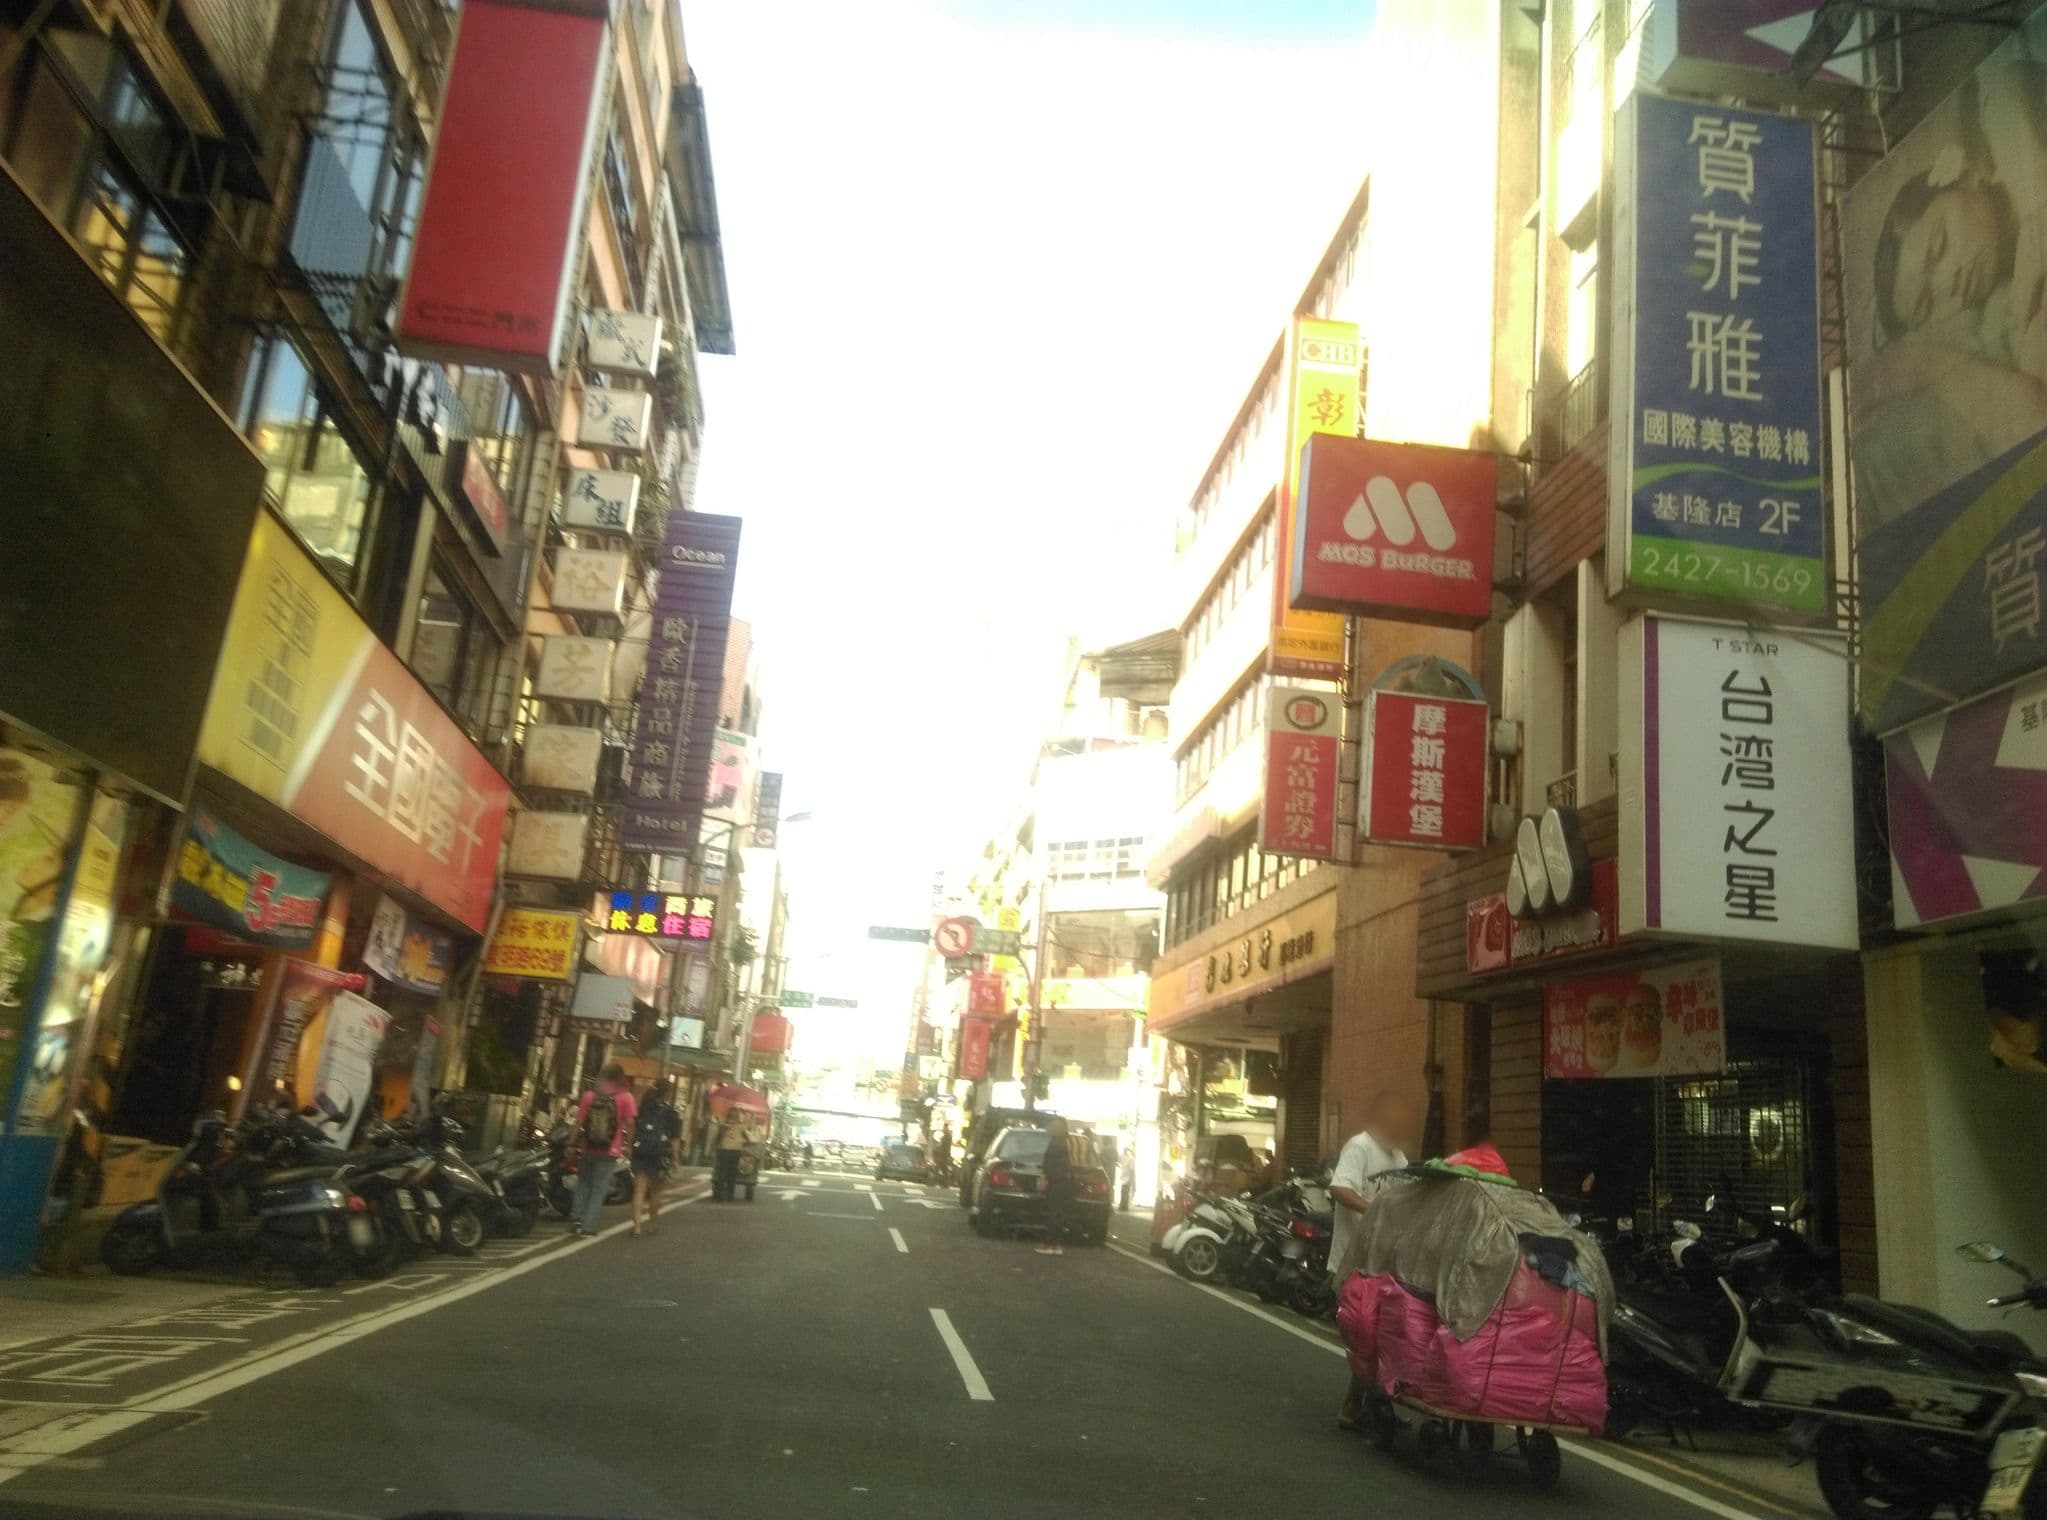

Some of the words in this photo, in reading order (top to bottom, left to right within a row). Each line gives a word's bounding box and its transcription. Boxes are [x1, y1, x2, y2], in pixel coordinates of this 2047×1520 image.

[1685, 116, 1764, 401] 質菲雅
[1643, 408, 1810, 467] 國際美容機構
[1652, 490, 1743, 530] 基隆店
[1758, 498, 1801, 535] 2F
[671, 543, 727, 564] Ocean
[1316, 541, 1376, 568] MOS
[1380, 551, 1475, 580] BURGER
[1642, 546, 1812, 596] 2427-1569
[1712, 638, 1722, 651] T
[1730, 639, 1779, 656] STAR
[1409, 703, 1447, 837] 摩斯漢堡
[636, 815, 687, 833] Hotel
